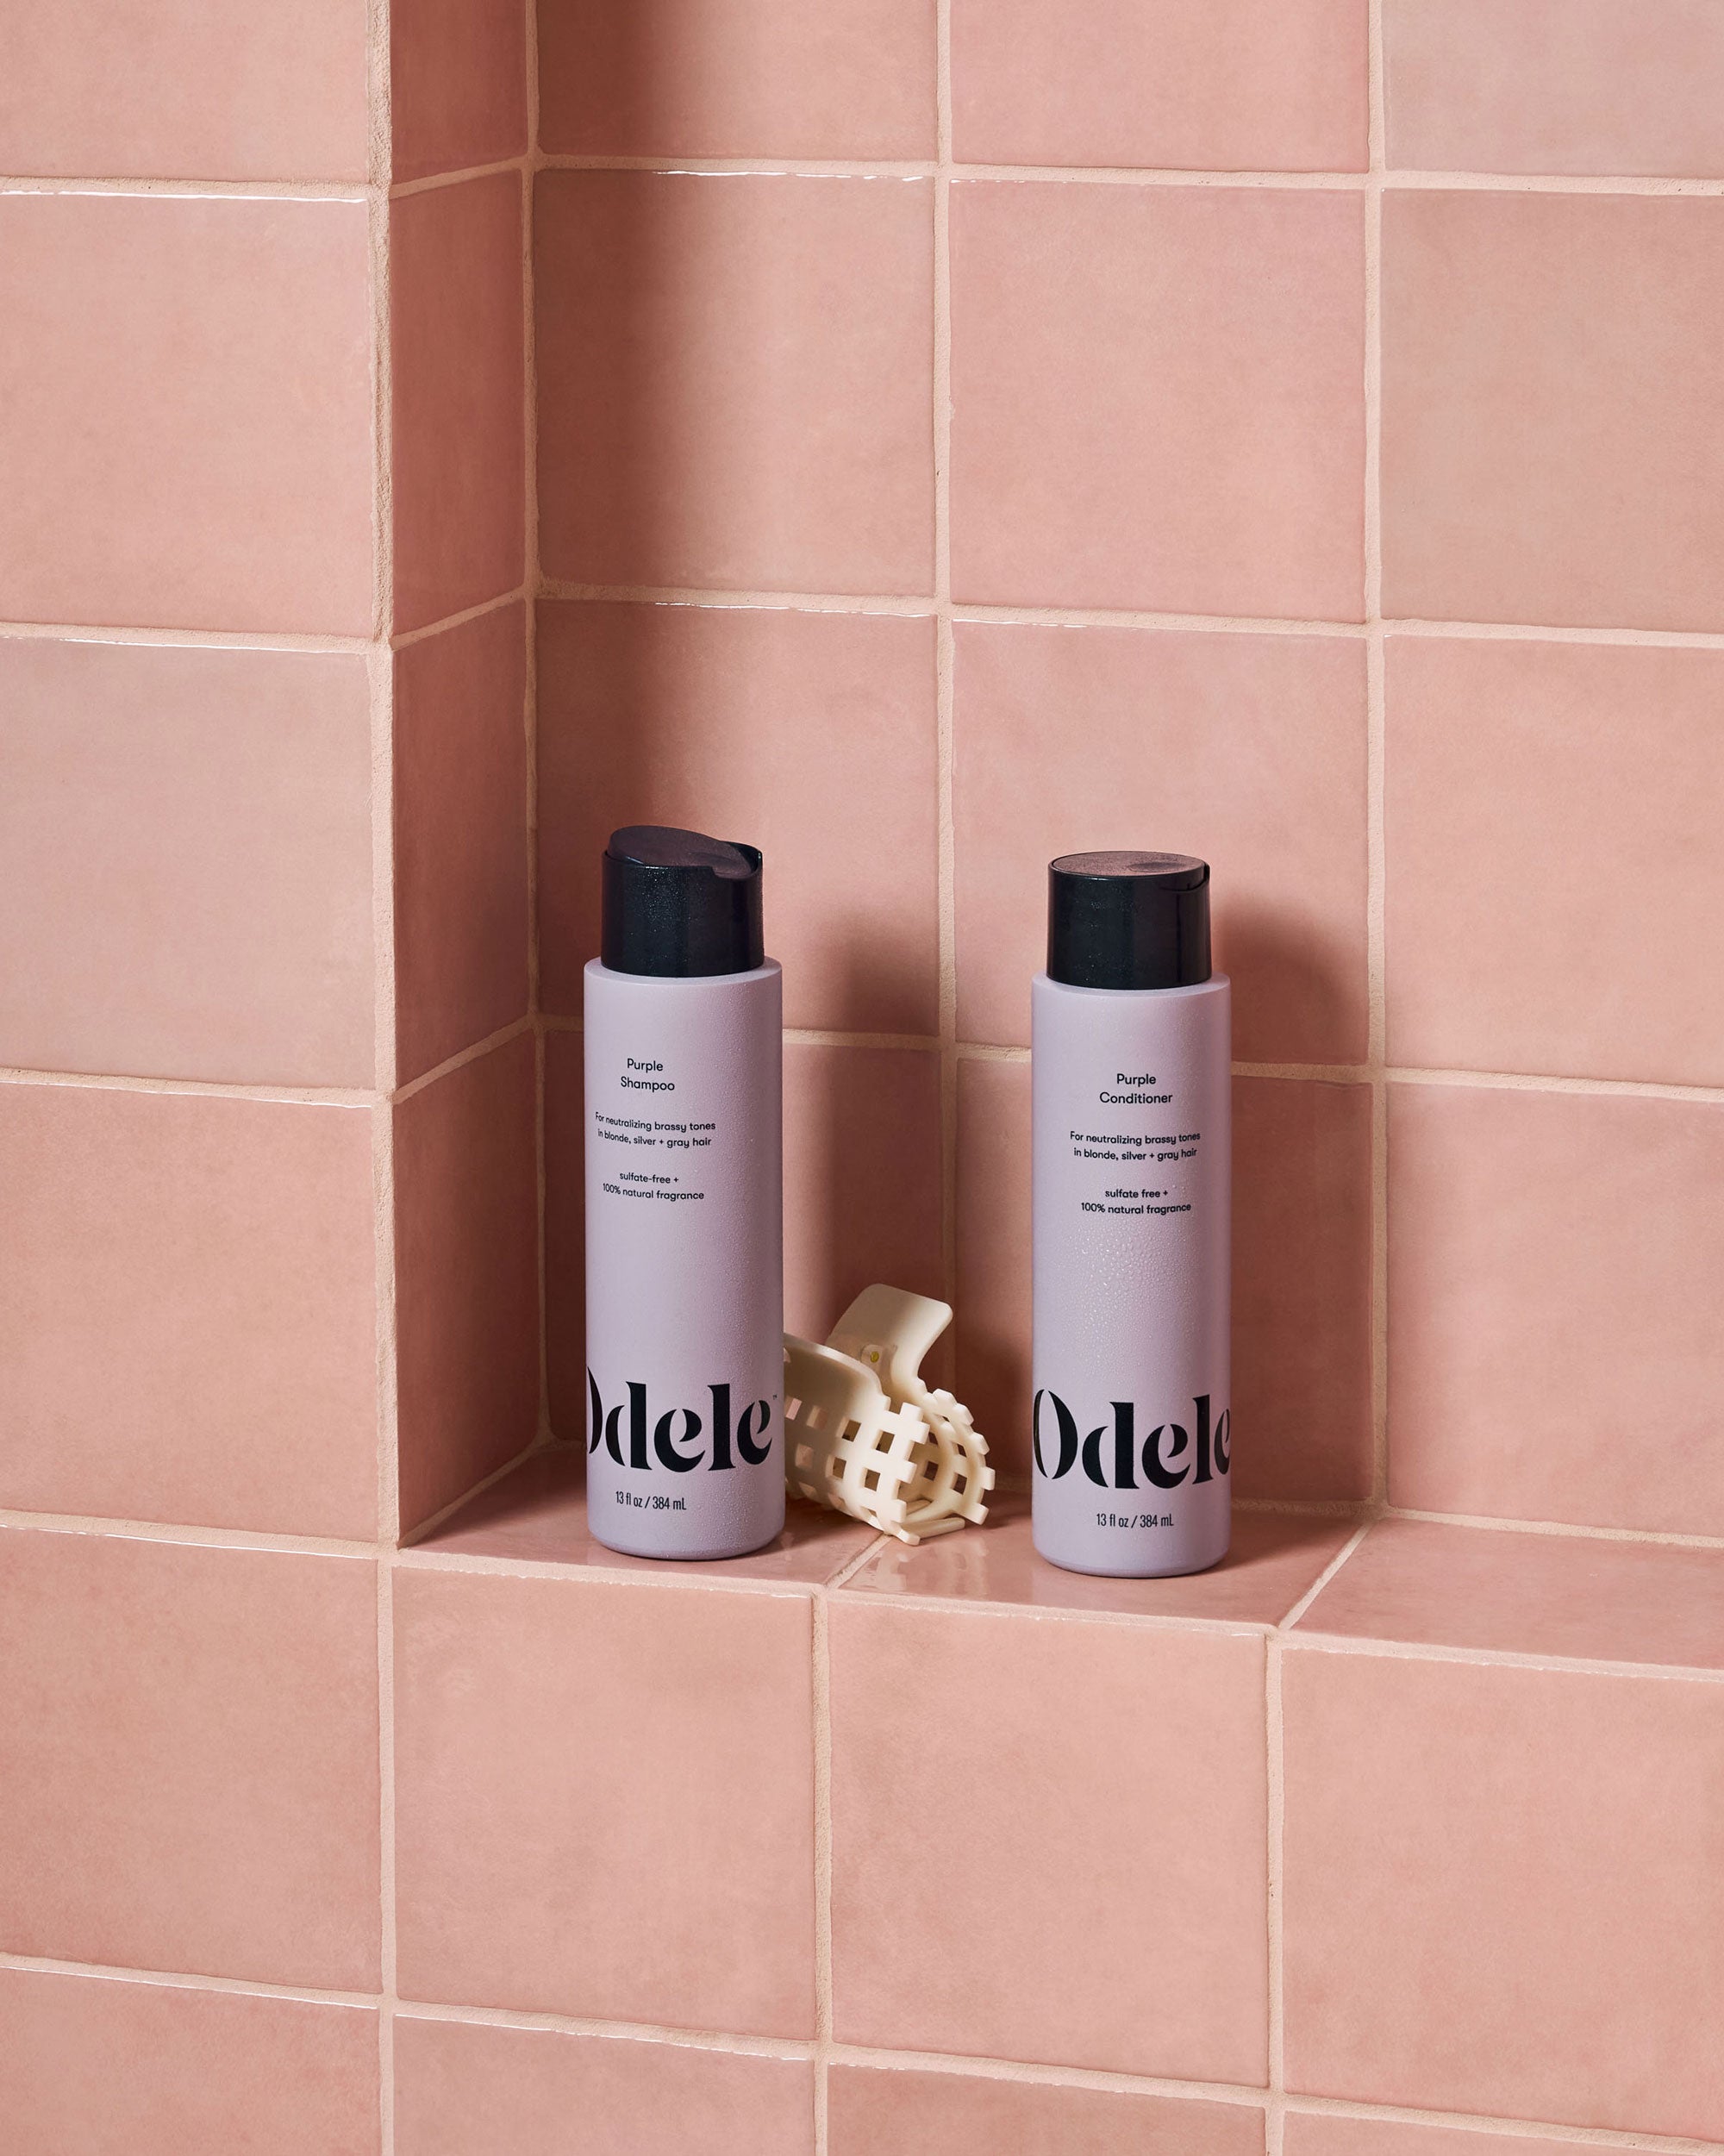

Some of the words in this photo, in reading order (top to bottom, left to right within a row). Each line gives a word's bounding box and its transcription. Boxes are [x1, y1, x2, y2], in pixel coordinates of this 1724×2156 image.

[628, 1058, 663, 1073] Purple
[621, 1077, 675, 1092] Shampoo
[1117, 1073, 1156, 1087] Purple
[1099, 1091, 1173, 1104] Conditioner
[596, 1112, 604, 1122] For
[606, 1117, 652, 1132] neutralizing
[654, 1122, 687, 1133] brassy
[690, 1122, 716, 1130] tones
[604, 1130, 631, 1144] blonde,
[634, 1136, 656, 1146] silver
[666, 1138, 690, 1148] gray
[1071, 1131, 1084, 1140] For
[1086, 1134, 1142, 1147] neutralizing
[1145, 1135, 1177, 1145] brassy
[1074, 1147, 1082, 1157] in
[1084, 1149, 1119, 1160] blonde,
[1121, 1152, 1146, 1160] silver
[1157, 1152, 1179, 1161] gray
[1181, 1148, 1197, 1157] hair
[620, 1172, 671, 1184] sulfate-free
[603, 1183, 621, 1195] 100%
[622, 1189, 653, 1198] natural
[656, 1190, 704, 1202] fragrance
[1105, 1189, 1139, 1198] sulfate
[1141, 1189, 1160, 1197] free
[1081, 1203, 1106, 1213] 100%
[1108, 1205, 1144, 1214] natural
[1146, 1203, 1191, 1215] fragrance
[1034, 1389, 1230, 1490] Odele
[615, 1490, 624, 1504] 13
[626, 1493, 631, 1505] fl
[634, 1497, 643, 1508] oz
[645, 1497, 650, 1509] /
[653, 1496, 670, 1509] 384
[673, 1497, 687, 1510] mL
[1096, 1513, 1106, 1527] 13
[1109, 1514, 1115, 1526] fl
[1118, 1517, 1128, 1528] oz
[1131, 1515, 1138, 1528] /
[1140, 1515, 1158, 1528] 384
[1161, 1514, 1174, 1527] mL
